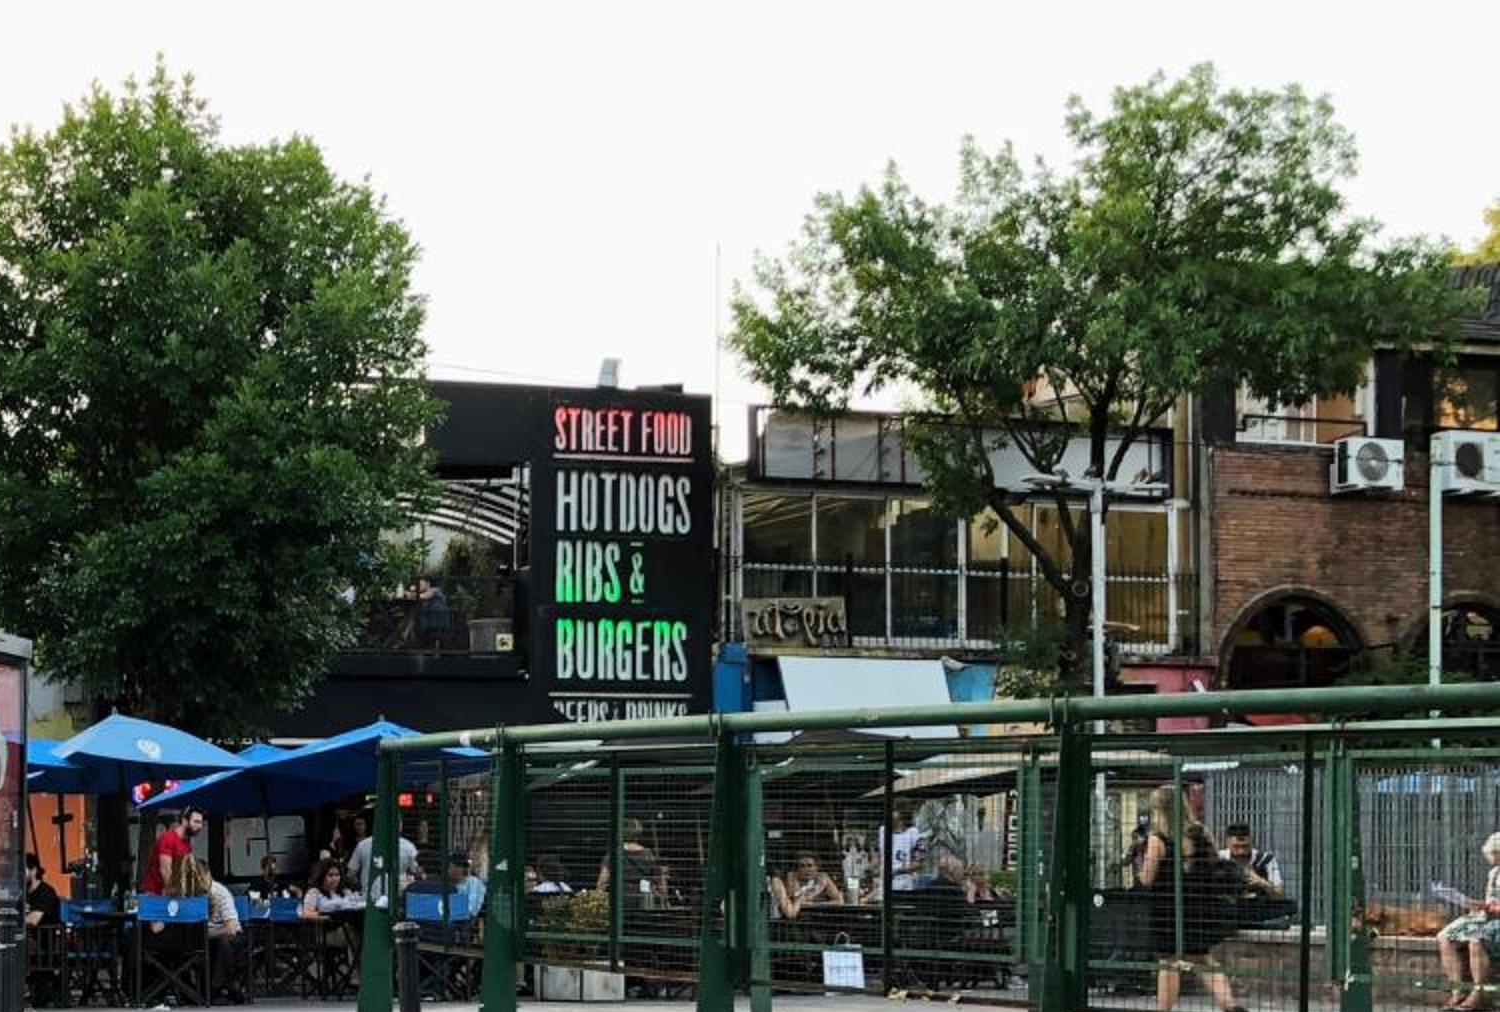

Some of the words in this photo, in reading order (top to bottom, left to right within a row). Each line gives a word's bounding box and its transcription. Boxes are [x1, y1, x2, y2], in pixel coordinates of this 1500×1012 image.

[554, 406, 633, 453] STREET
[640, 410, 692, 455] FOOD
[555, 470, 692, 535] HOTDOGS
[555, 539, 622, 604] RIBS
[629, 552, 645, 596] &
[556, 617, 688, 682] BURGERS
